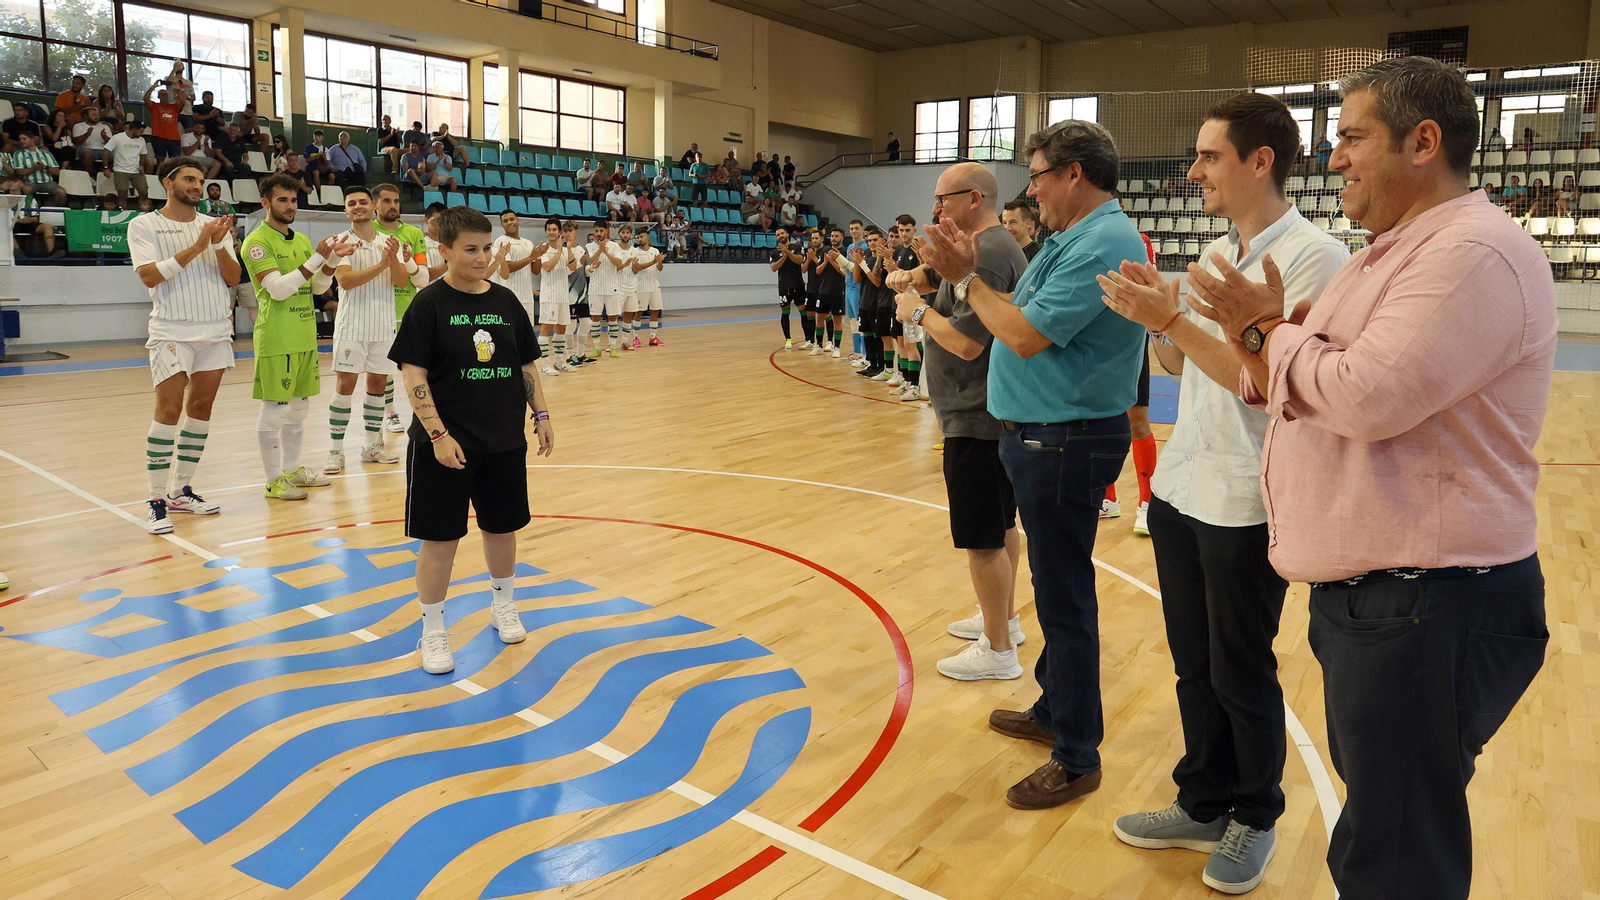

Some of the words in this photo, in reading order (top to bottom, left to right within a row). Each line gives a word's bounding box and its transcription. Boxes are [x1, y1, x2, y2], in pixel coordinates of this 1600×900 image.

[450, 314, 473, 326] AMOR,
[460, 369, 466, 379] Y
[466, 367, 495, 380] CERVEZA
[497, 367, 512, 378] FRIA
